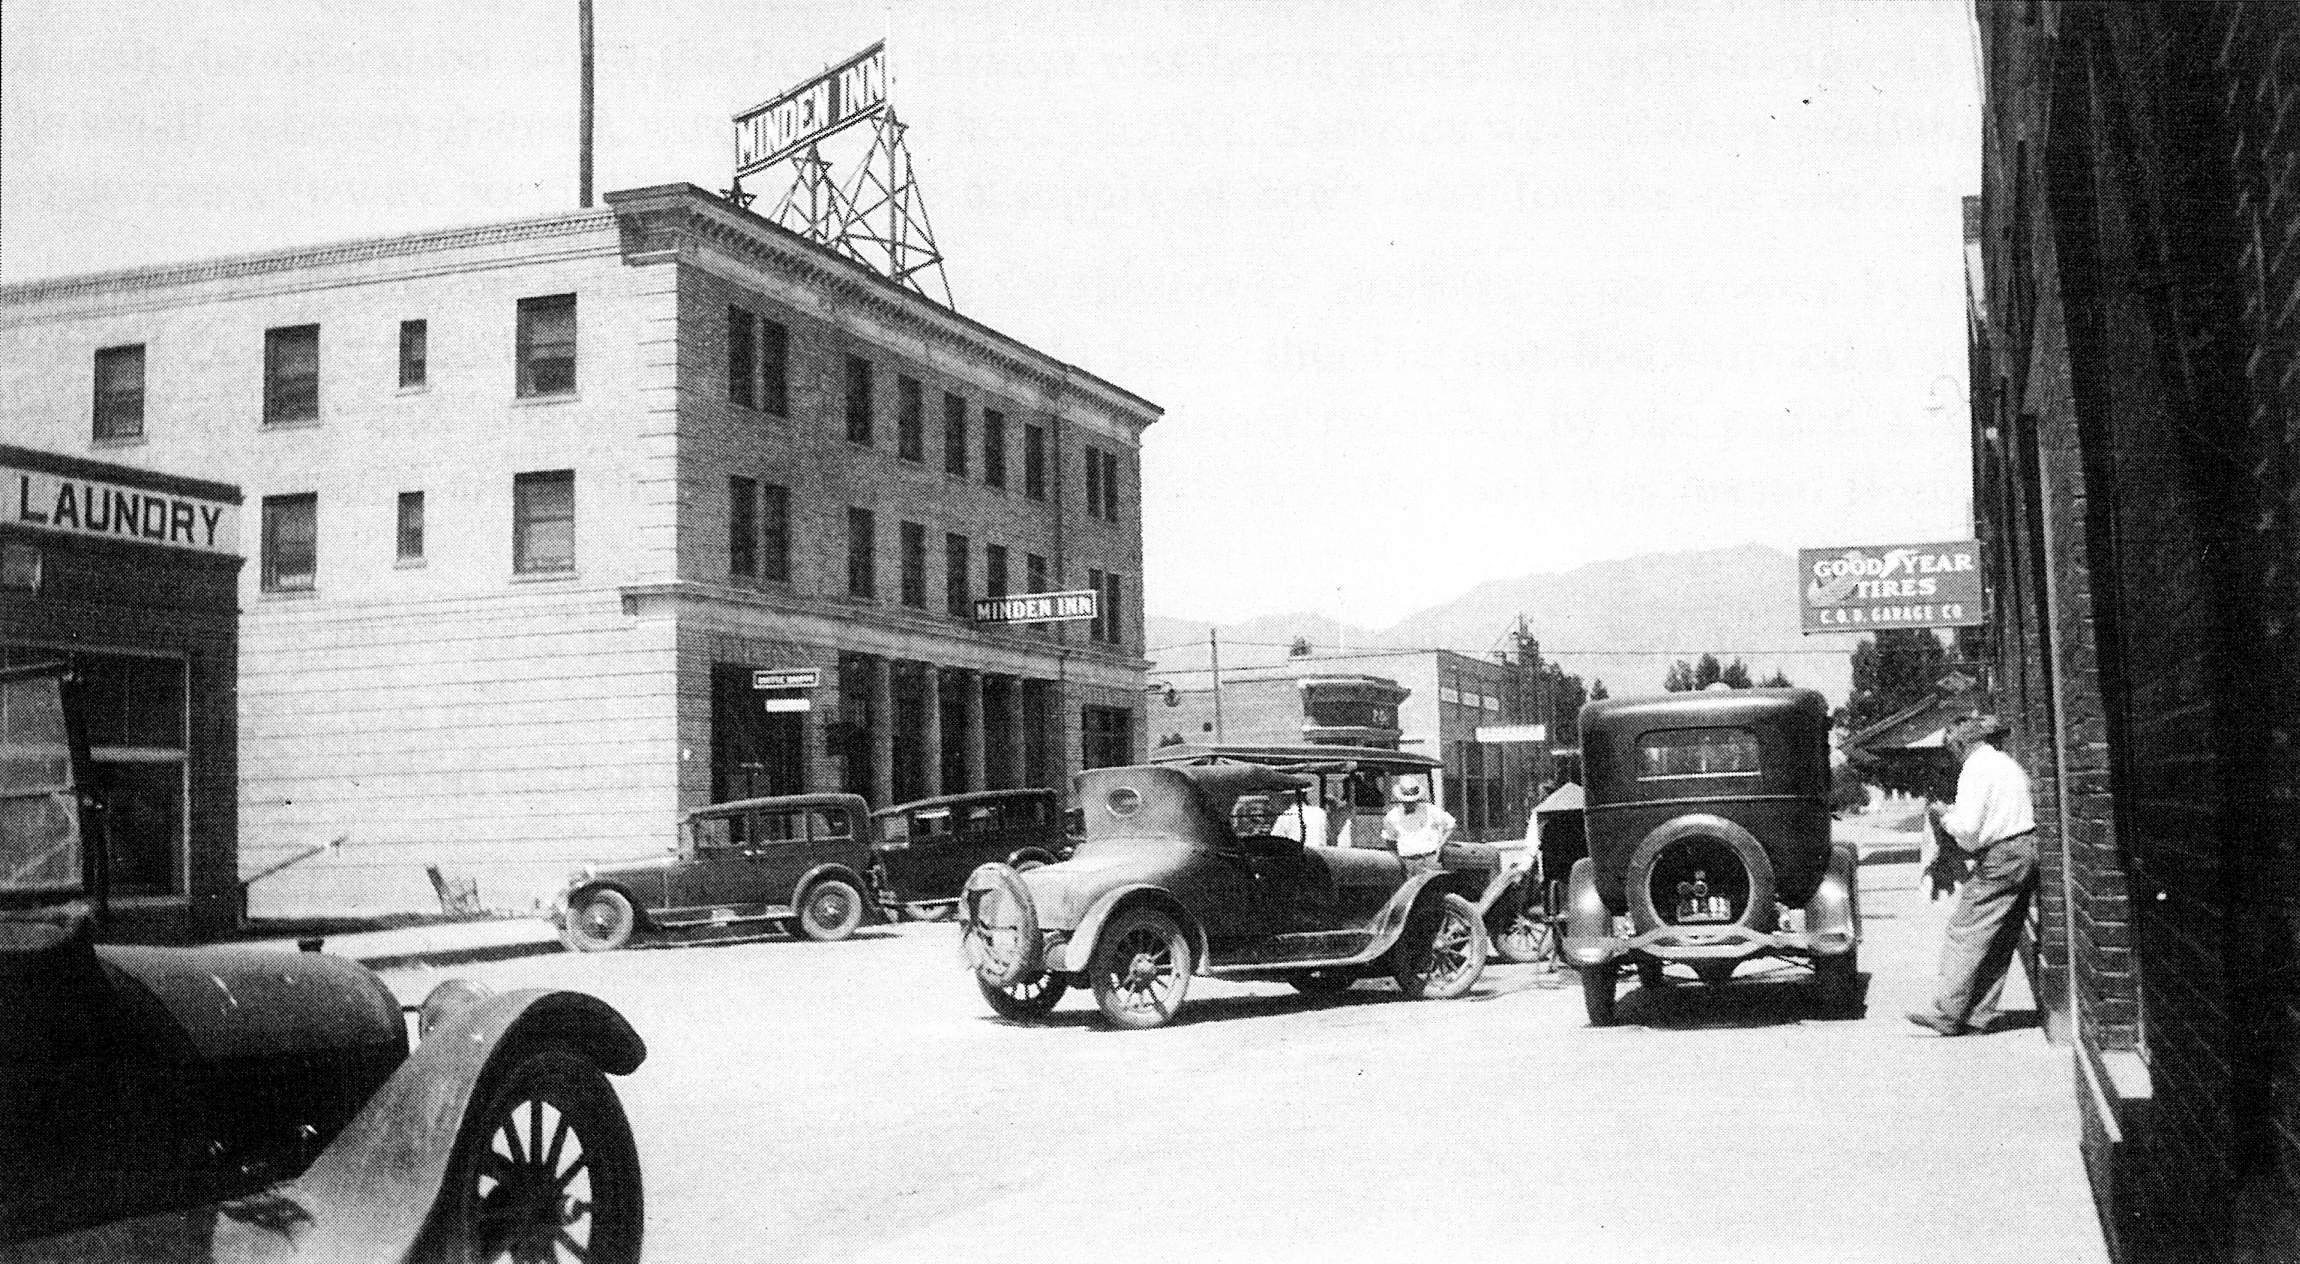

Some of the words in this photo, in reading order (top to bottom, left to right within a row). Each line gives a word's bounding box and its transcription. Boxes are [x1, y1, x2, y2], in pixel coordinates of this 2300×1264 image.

[736, 78, 830, 168] MINDEN
[839, 52, 886, 123] INN
[20, 475, 223, 546] LAUNDRY
[1857, 578, 1937, 598] TIRES
[976, 599, 1051, 621] MINDEN
[1057, 596, 1092, 617] INN
[1871, 605, 1934, 623] GARAGE
